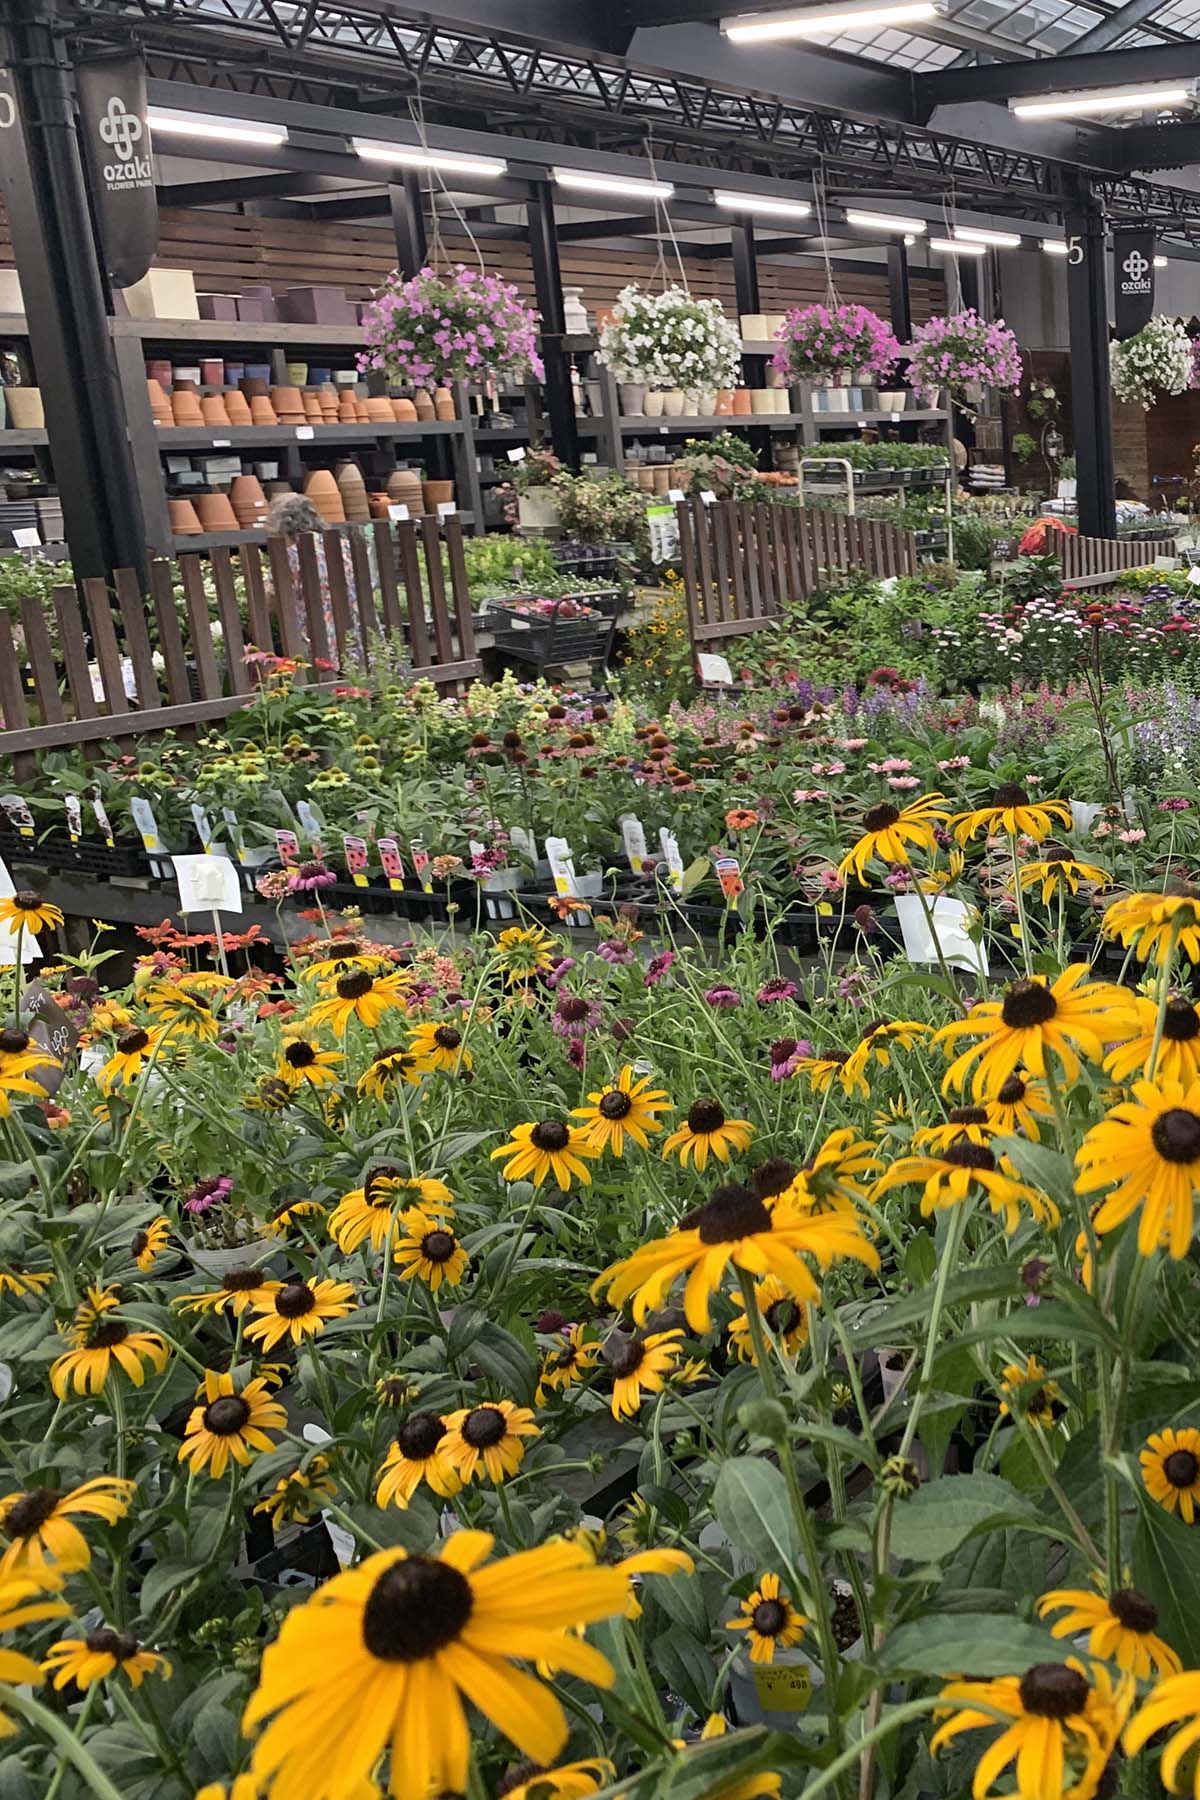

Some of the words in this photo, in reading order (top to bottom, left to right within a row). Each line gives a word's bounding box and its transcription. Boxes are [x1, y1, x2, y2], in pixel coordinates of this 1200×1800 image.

[104, 154, 152, 181] ozaki
[1068, 236, 1084, 264] 5
[1121, 278, 1151, 290] ozaki
